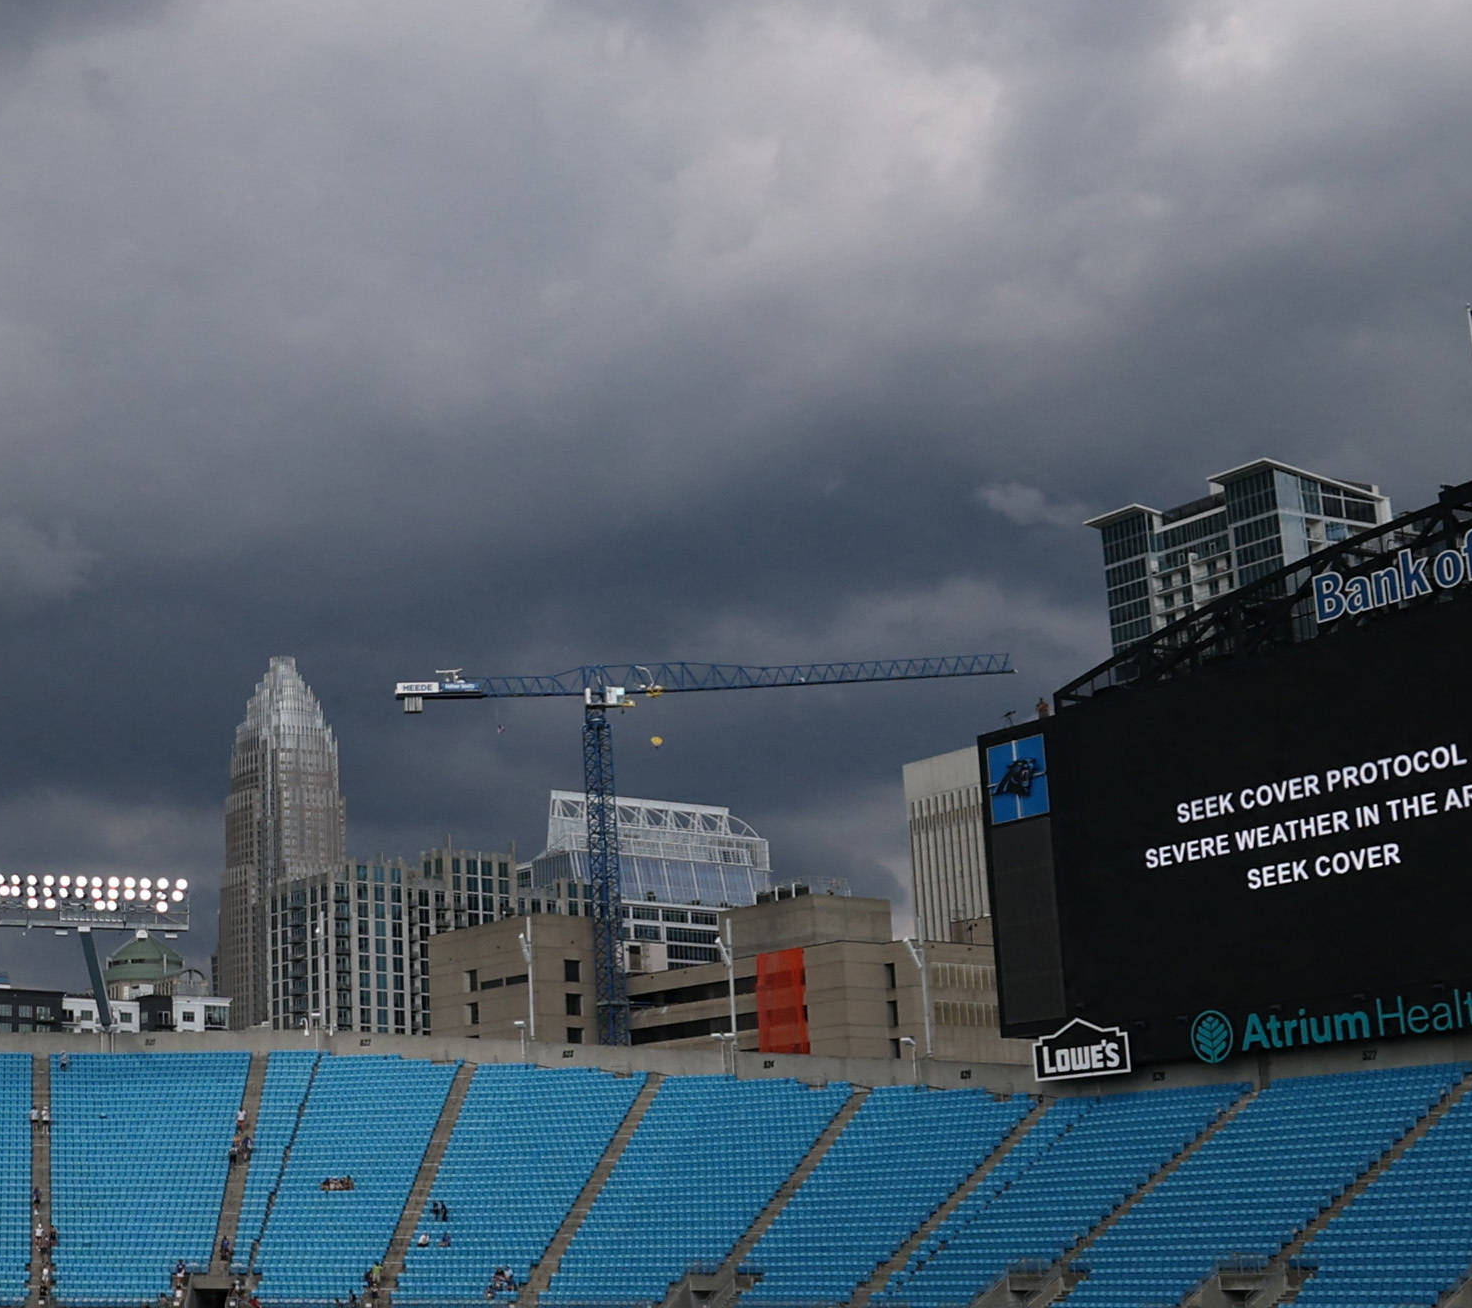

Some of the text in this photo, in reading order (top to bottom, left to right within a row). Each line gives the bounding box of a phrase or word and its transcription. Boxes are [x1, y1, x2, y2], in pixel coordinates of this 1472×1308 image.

[1311, 549, 1434, 624] Bank
[402, 682, 434, 693] HEEDE
[1176, 743, 1468, 824] SEEK COVER PROTOCOL
[1145, 833, 1231, 869] SEVERE
[1234, 810, 1350, 851] WEATHER
[1355, 803, 1380, 828] IN
[1385, 792, 1438, 822] THE
[1247, 843, 1401, 890] SEEK COVER
[1241, 1007, 1373, 1054] Atrium
[1042, 1037, 1121, 1073] LOWE'S
